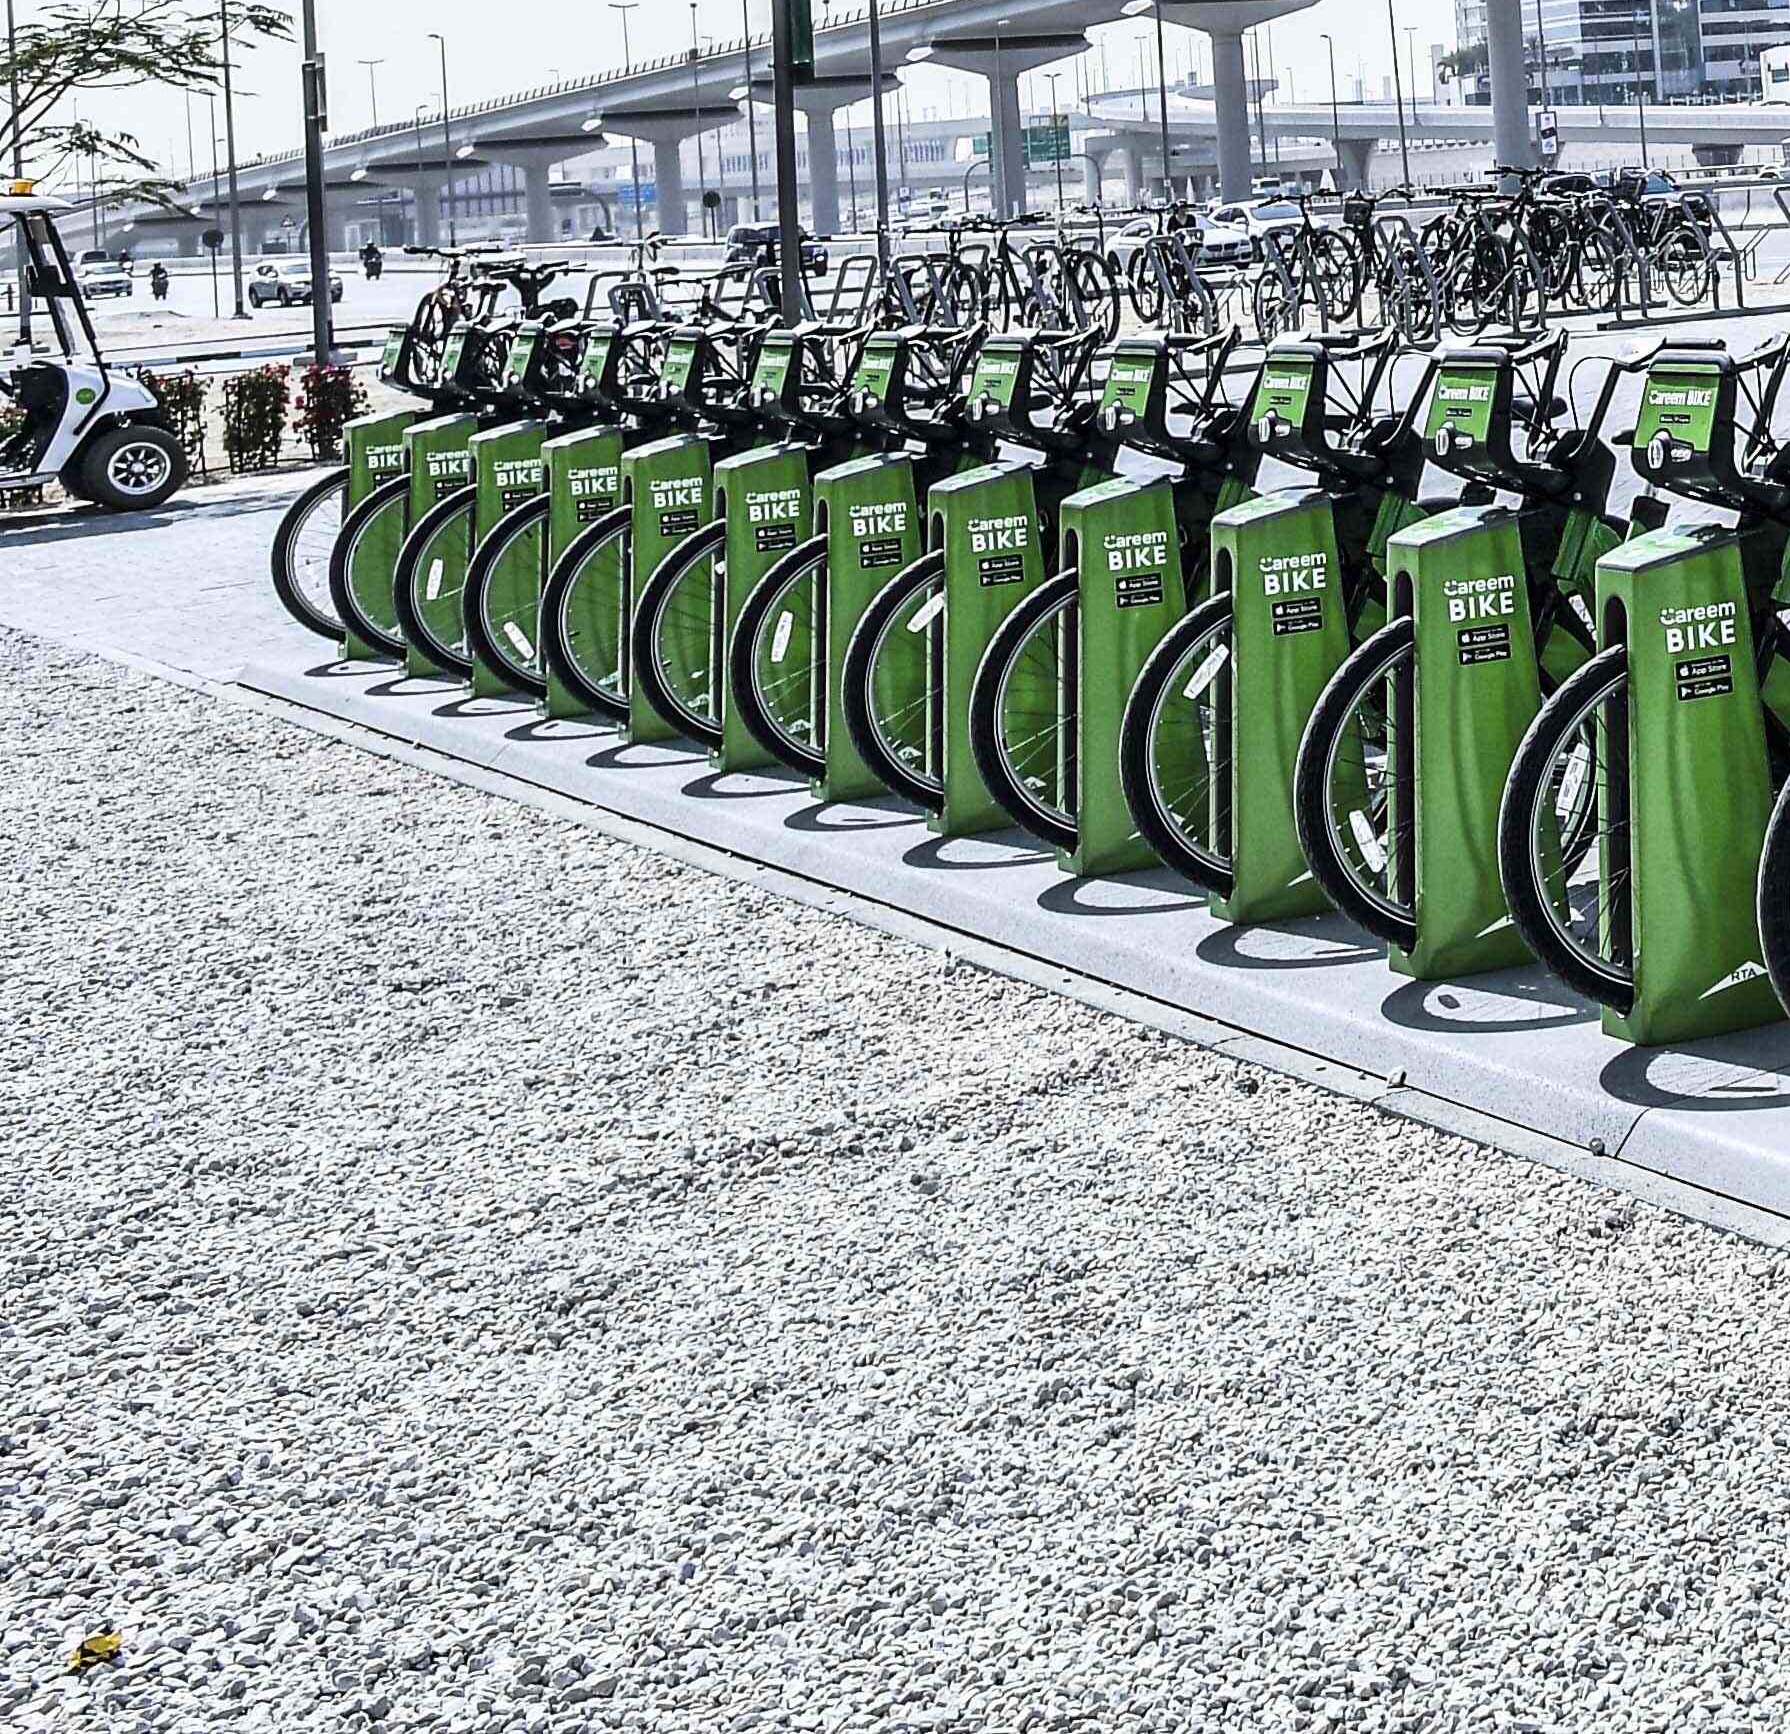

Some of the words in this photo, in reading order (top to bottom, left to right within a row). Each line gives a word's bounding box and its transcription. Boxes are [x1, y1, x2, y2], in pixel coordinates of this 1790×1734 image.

[496, 468, 542, 486] BIKE
[568, 466, 618, 479] Careem
[571, 477, 618, 495] BIKE
[650, 477, 703, 492] Careem
[654, 488, 702, 508] BIKE
[745, 488, 800, 503] Careem
[750, 501, 800, 522] BIKE
[849, 501, 907, 517] Careem
[853, 515, 906, 536] BIKE
[968, 515, 1027, 532] Careem
[972, 529, 1027, 553] BIKE
[1104, 531, 1167, 549] Careem
[1108, 545, 1167, 571] BIKE
[1259, 552, 1326, 572] Careem
[1264, 567, 1326, 595] BIKE
[1443, 575, 1514, 596] Careem
[1449, 592, 1514, 622] BIKE
[1660, 602, 1735, 626] Careem
[1666, 619, 1736, 653] BIKE
[1731, 968, 1758, 981] RTA
